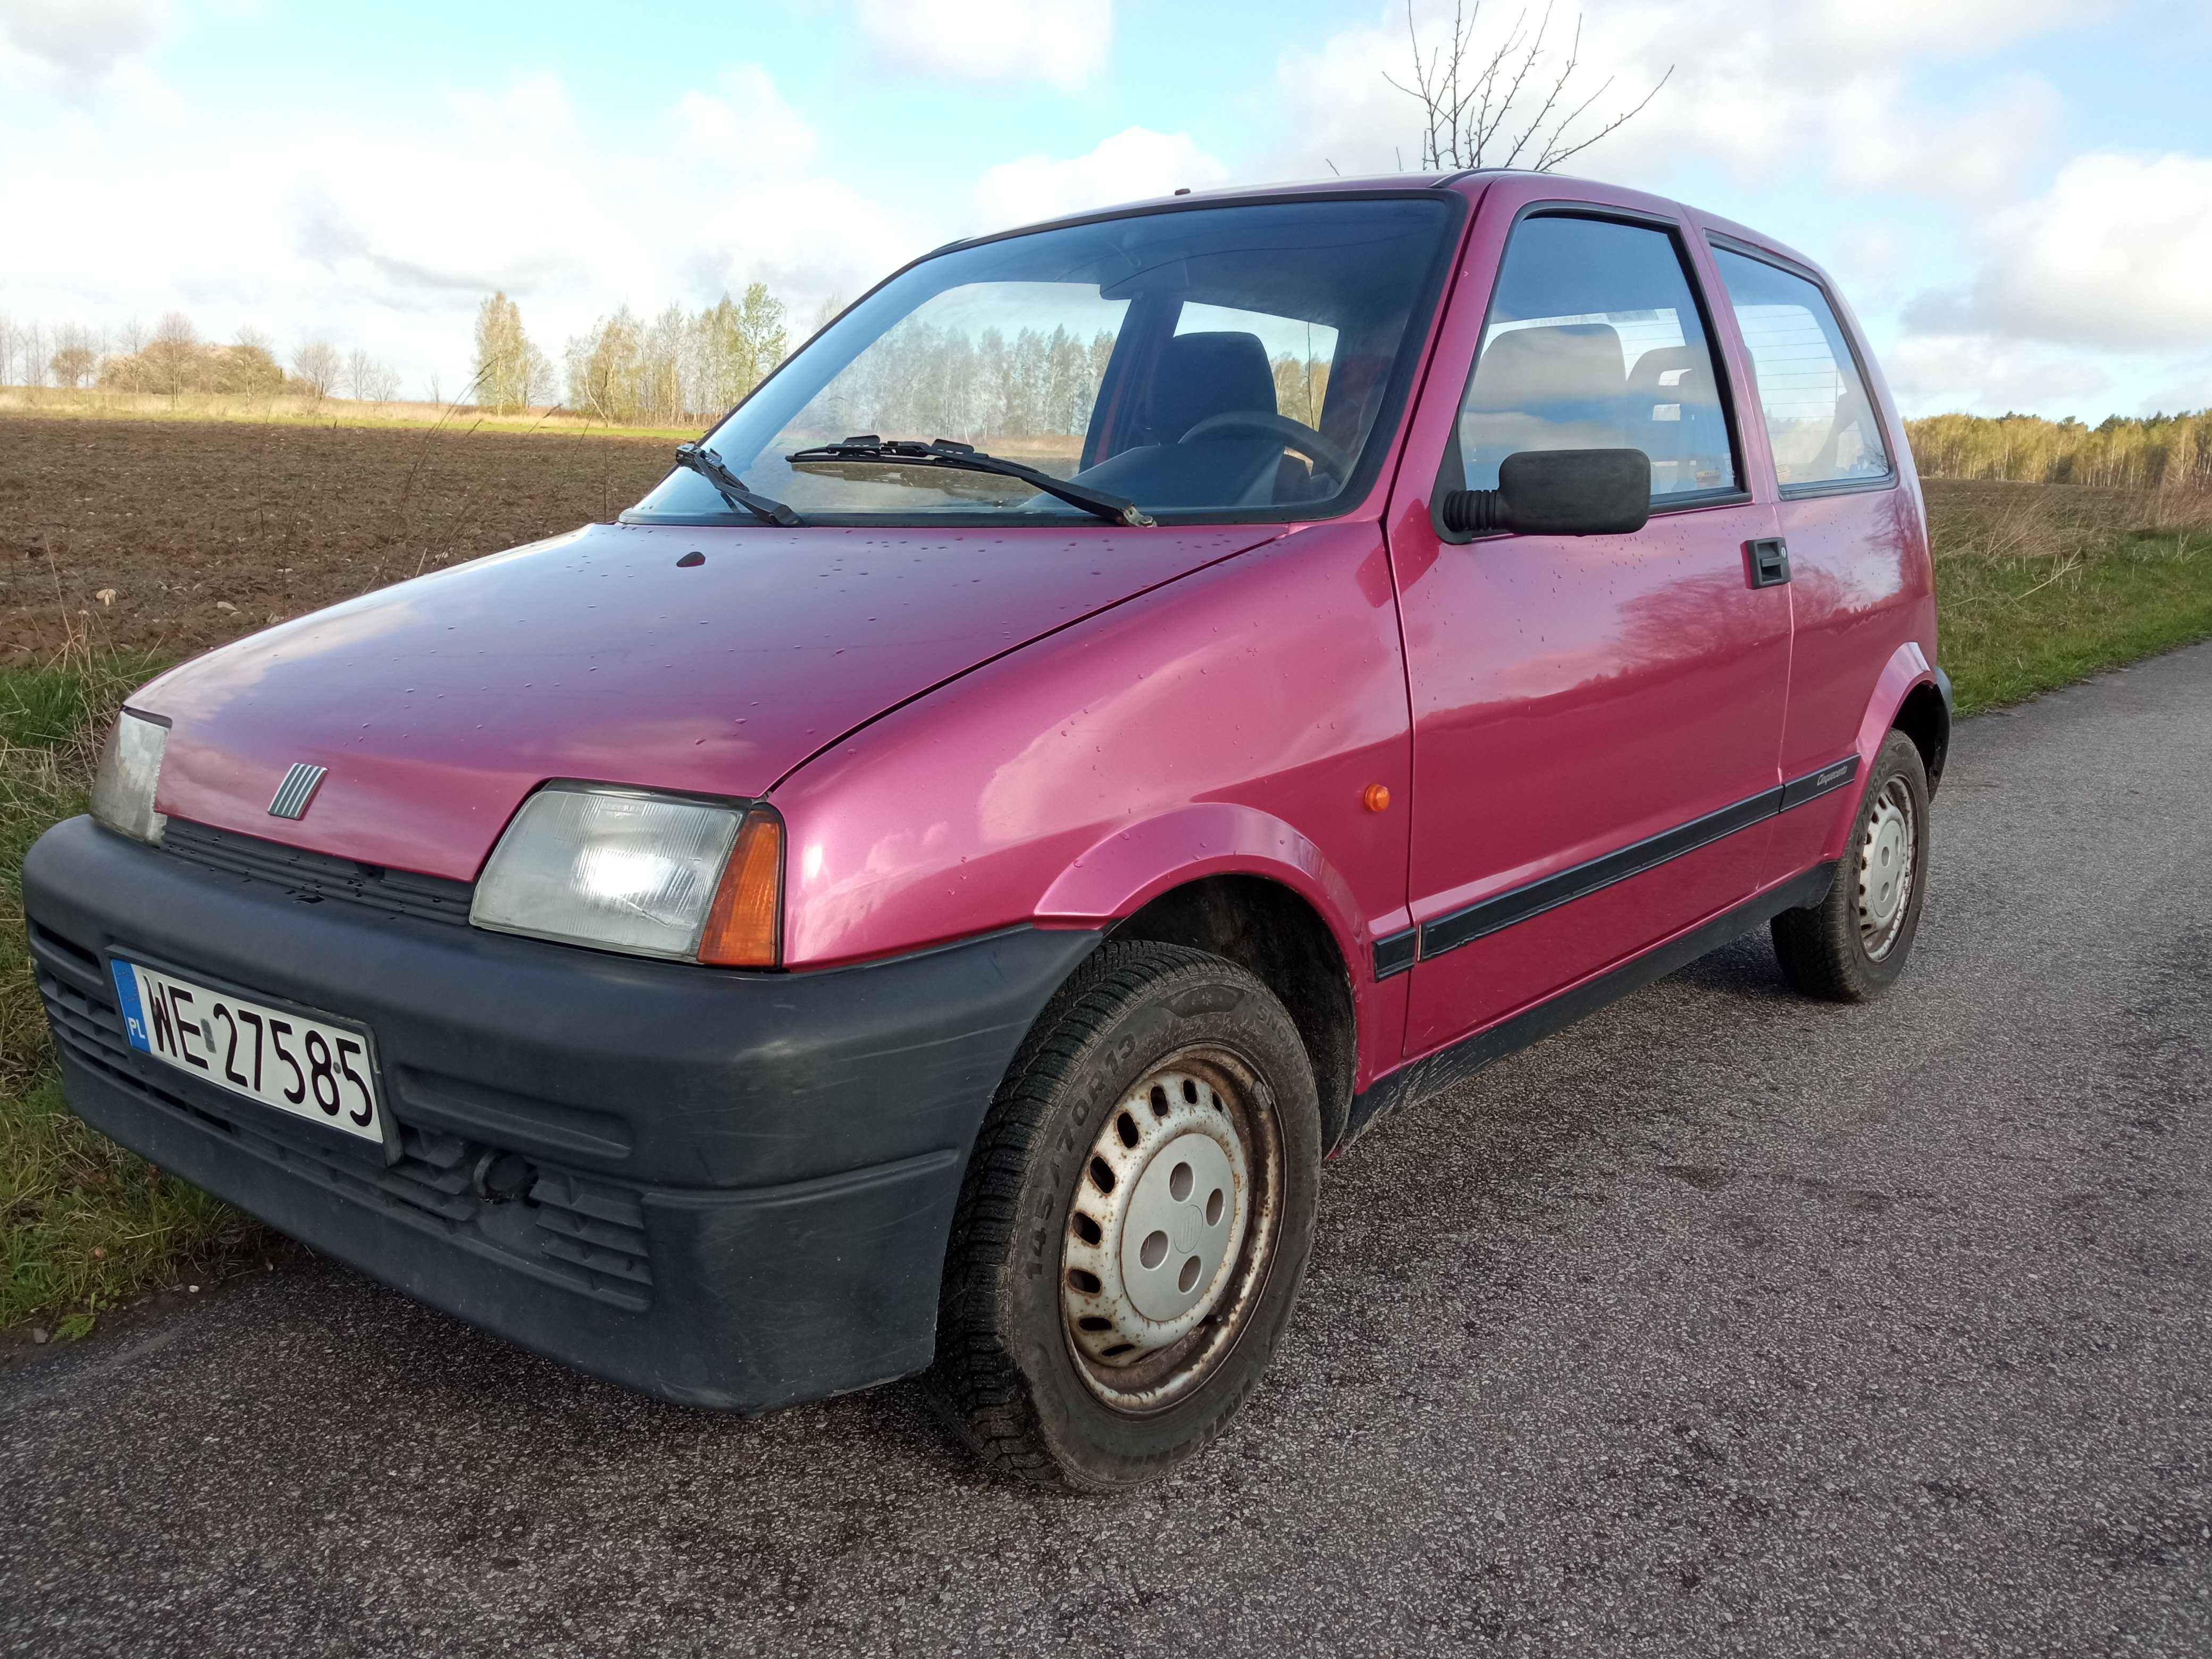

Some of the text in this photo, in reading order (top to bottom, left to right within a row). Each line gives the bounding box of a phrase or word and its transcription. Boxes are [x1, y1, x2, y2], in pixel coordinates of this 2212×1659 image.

[128, 1017, 146, 1040] PL
[143, 975, 373, 1127] WE 27585
